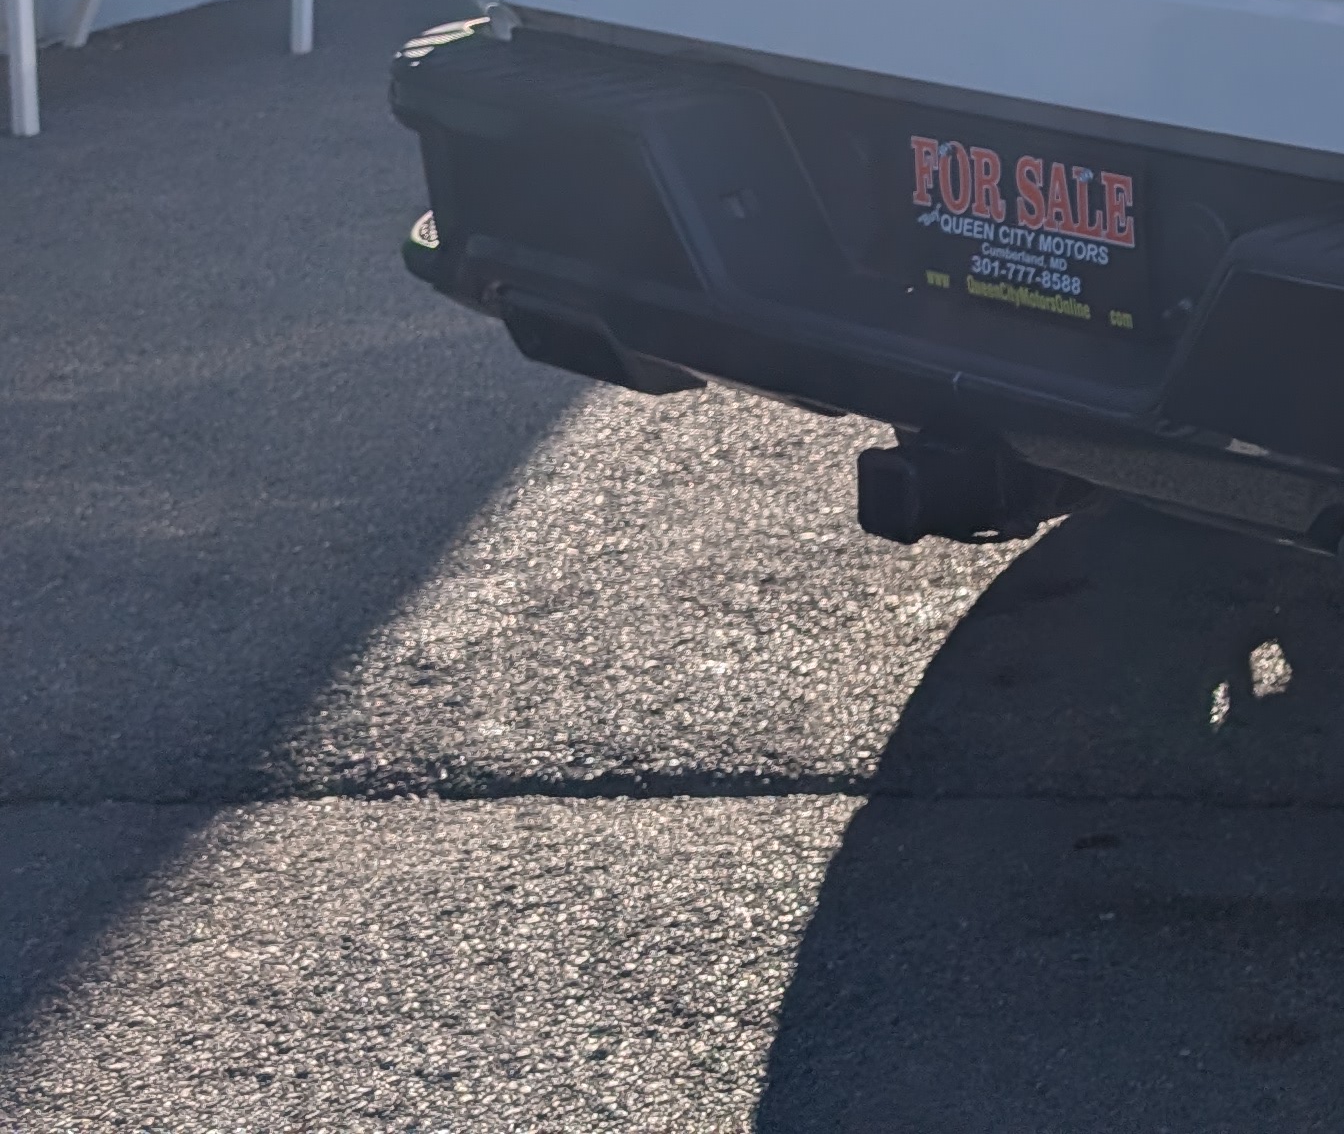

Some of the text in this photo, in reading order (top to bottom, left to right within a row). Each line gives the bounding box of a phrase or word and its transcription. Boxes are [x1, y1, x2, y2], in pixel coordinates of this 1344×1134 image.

[910, 135, 1136, 248] FOR SALE
[940, 214, 995, 240] QUEEN
[999, 226, 1036, 246] CITY
[1039, 236, 1109, 265] MOTORS
[981, 242, 1068, 271] Cumberland, MD
[971, 255, 1081, 295] 301-777-8588
